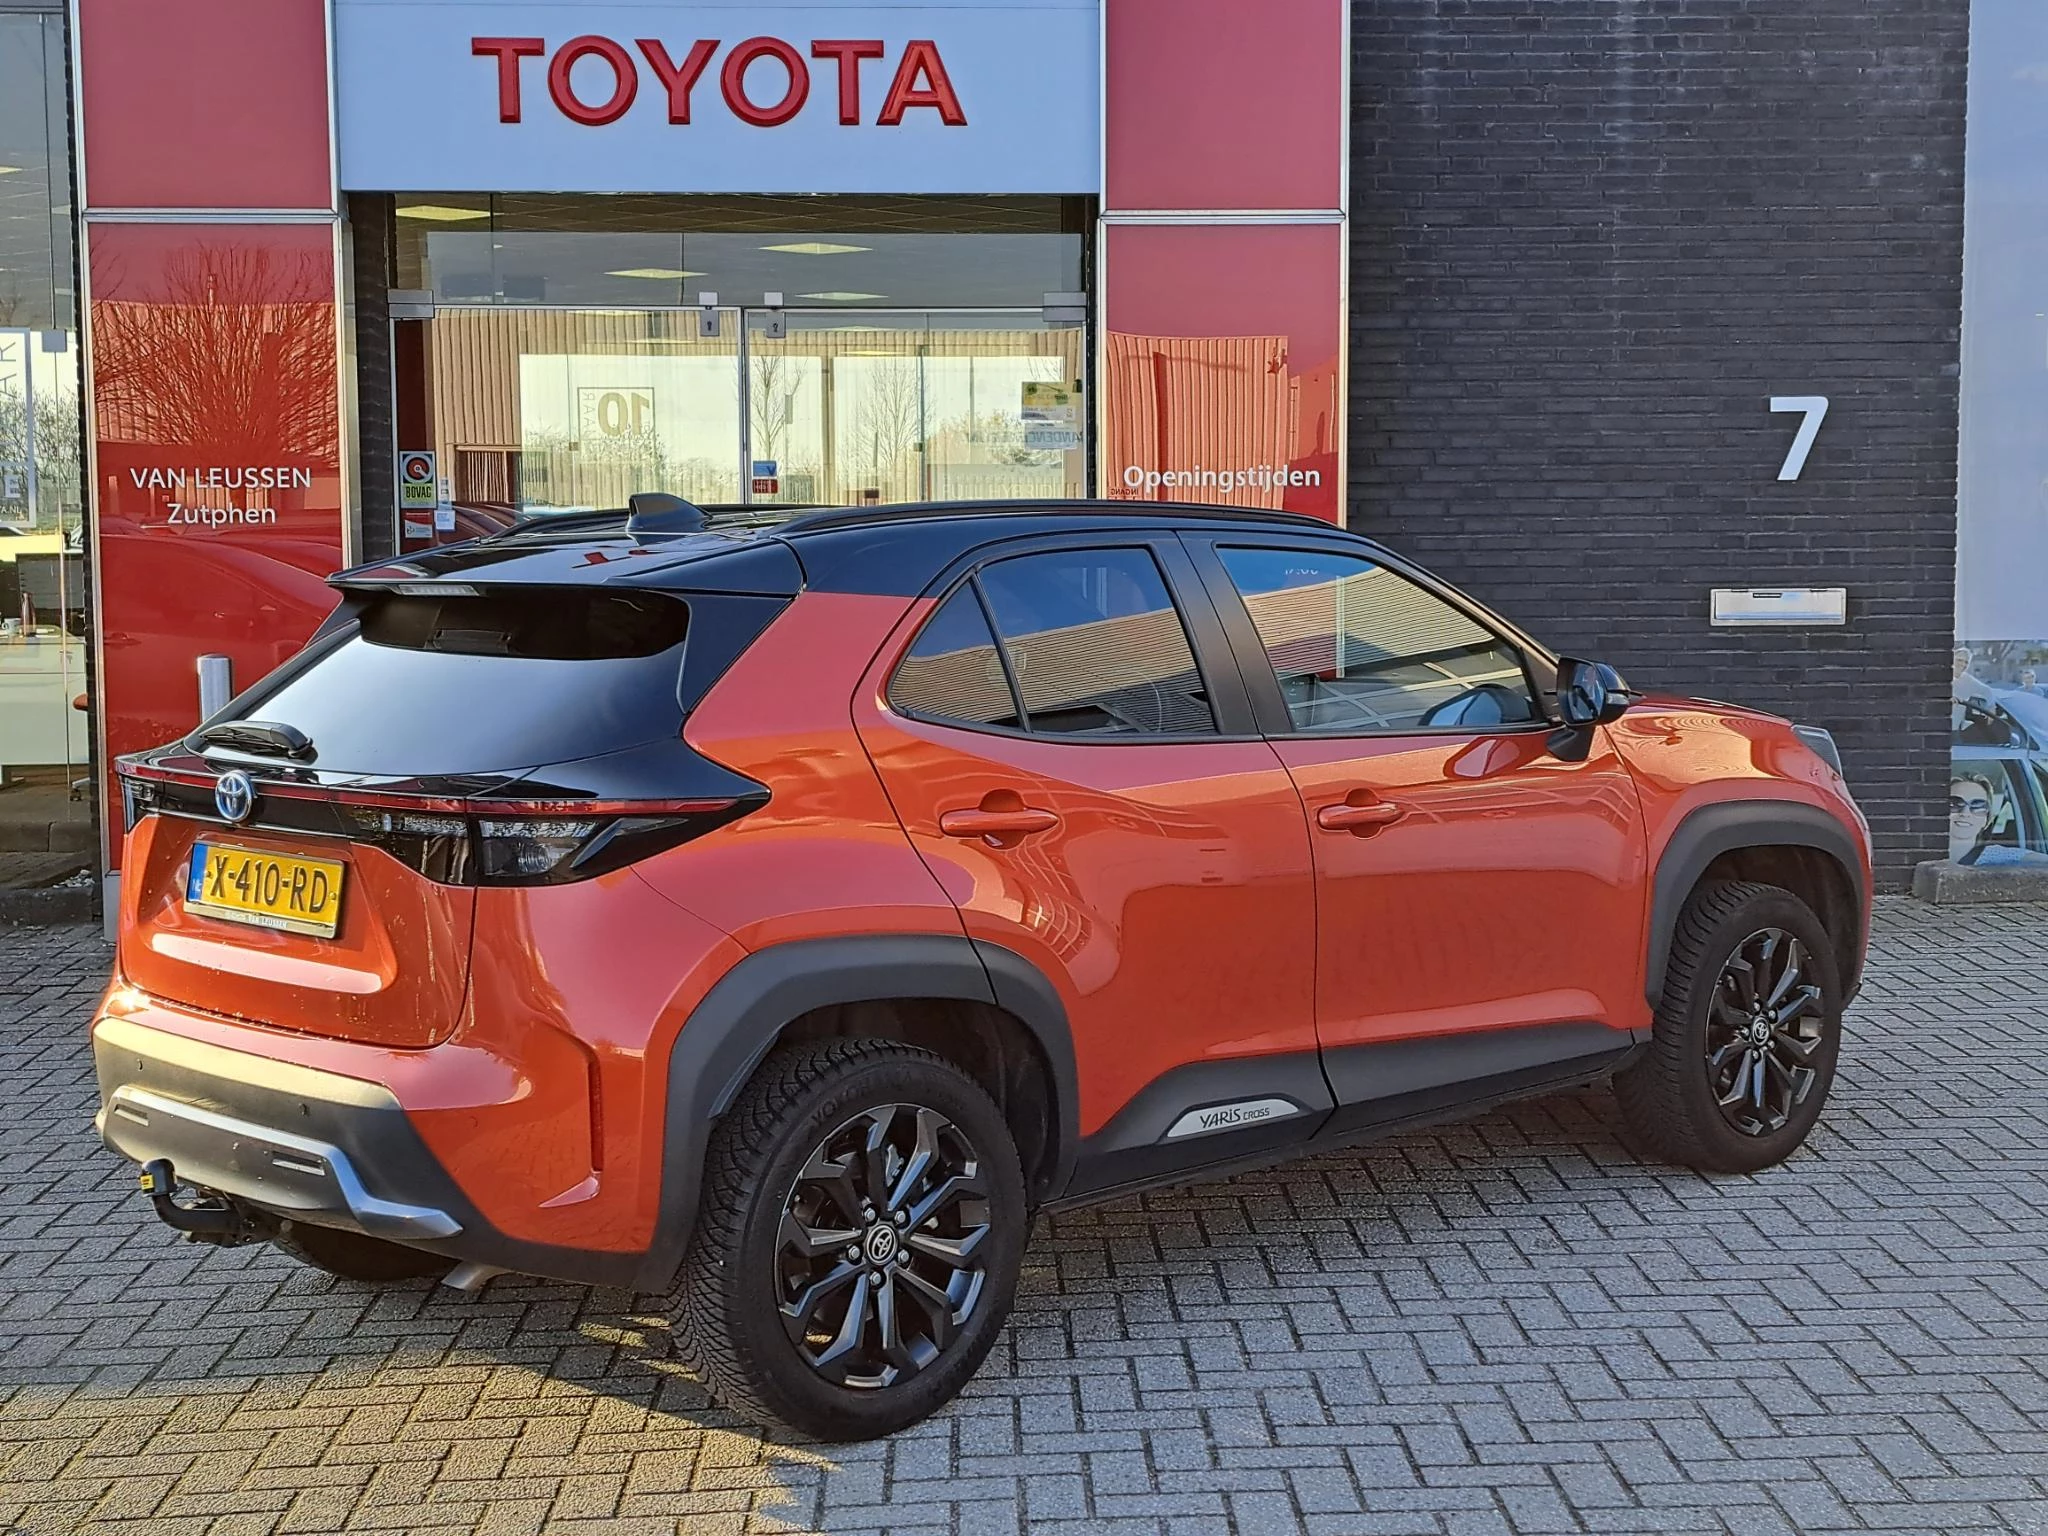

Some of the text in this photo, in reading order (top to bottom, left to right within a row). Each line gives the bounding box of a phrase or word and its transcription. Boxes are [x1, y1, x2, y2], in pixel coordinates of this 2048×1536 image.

[471, 34, 968, 127] TOYOTA
[1769, 396, 1829, 481] 7
[130, 467, 312, 489] VAN LEUSSEN
[1123, 464, 1320, 494] Openingstijden
[166, 502, 276, 528] Zutphen
[210, 854, 328, 914] X-410-RD
[1200, 1107, 1270, 1128] YARIS CROSS
